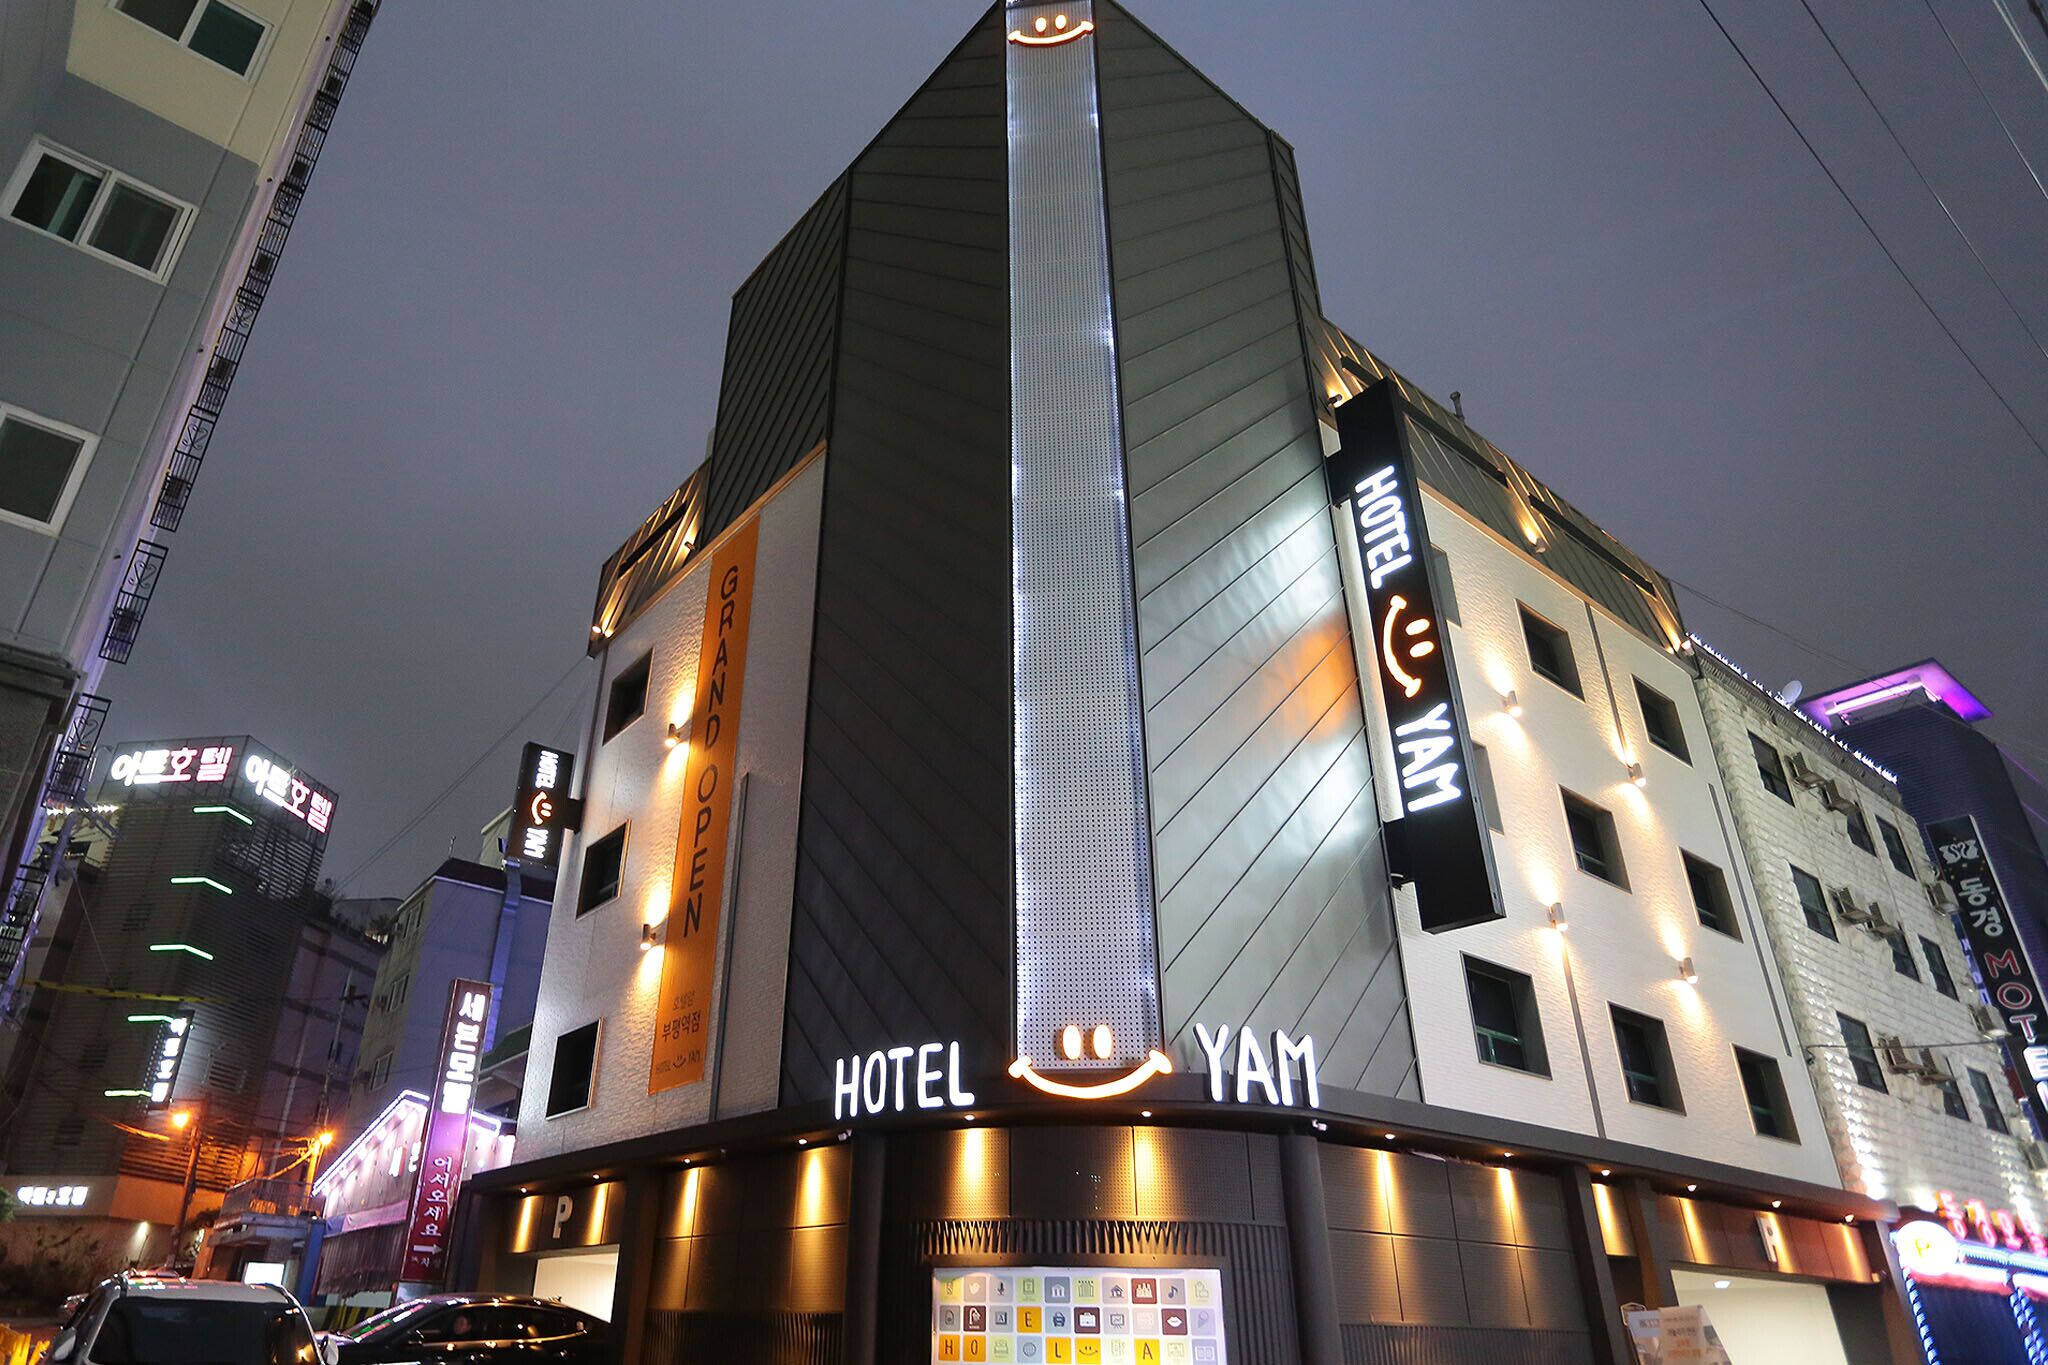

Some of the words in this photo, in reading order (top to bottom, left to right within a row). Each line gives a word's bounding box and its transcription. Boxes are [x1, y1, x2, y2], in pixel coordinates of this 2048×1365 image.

[705, 564, 739, 749] GRAND
[1354, 464, 1413, 590] HOTEL
[1395, 702, 1462, 813] YAM
[683, 763, 719, 938] OPEN
[441, 991, 486, 1115] 세븐모
[834, 1041, 975, 1120] HOTEL
[1194, 1022, 1319, 1108] YAM
[421, 1155, 453, 1237] 어서오세요
[552, 1195, 574, 1239] P
